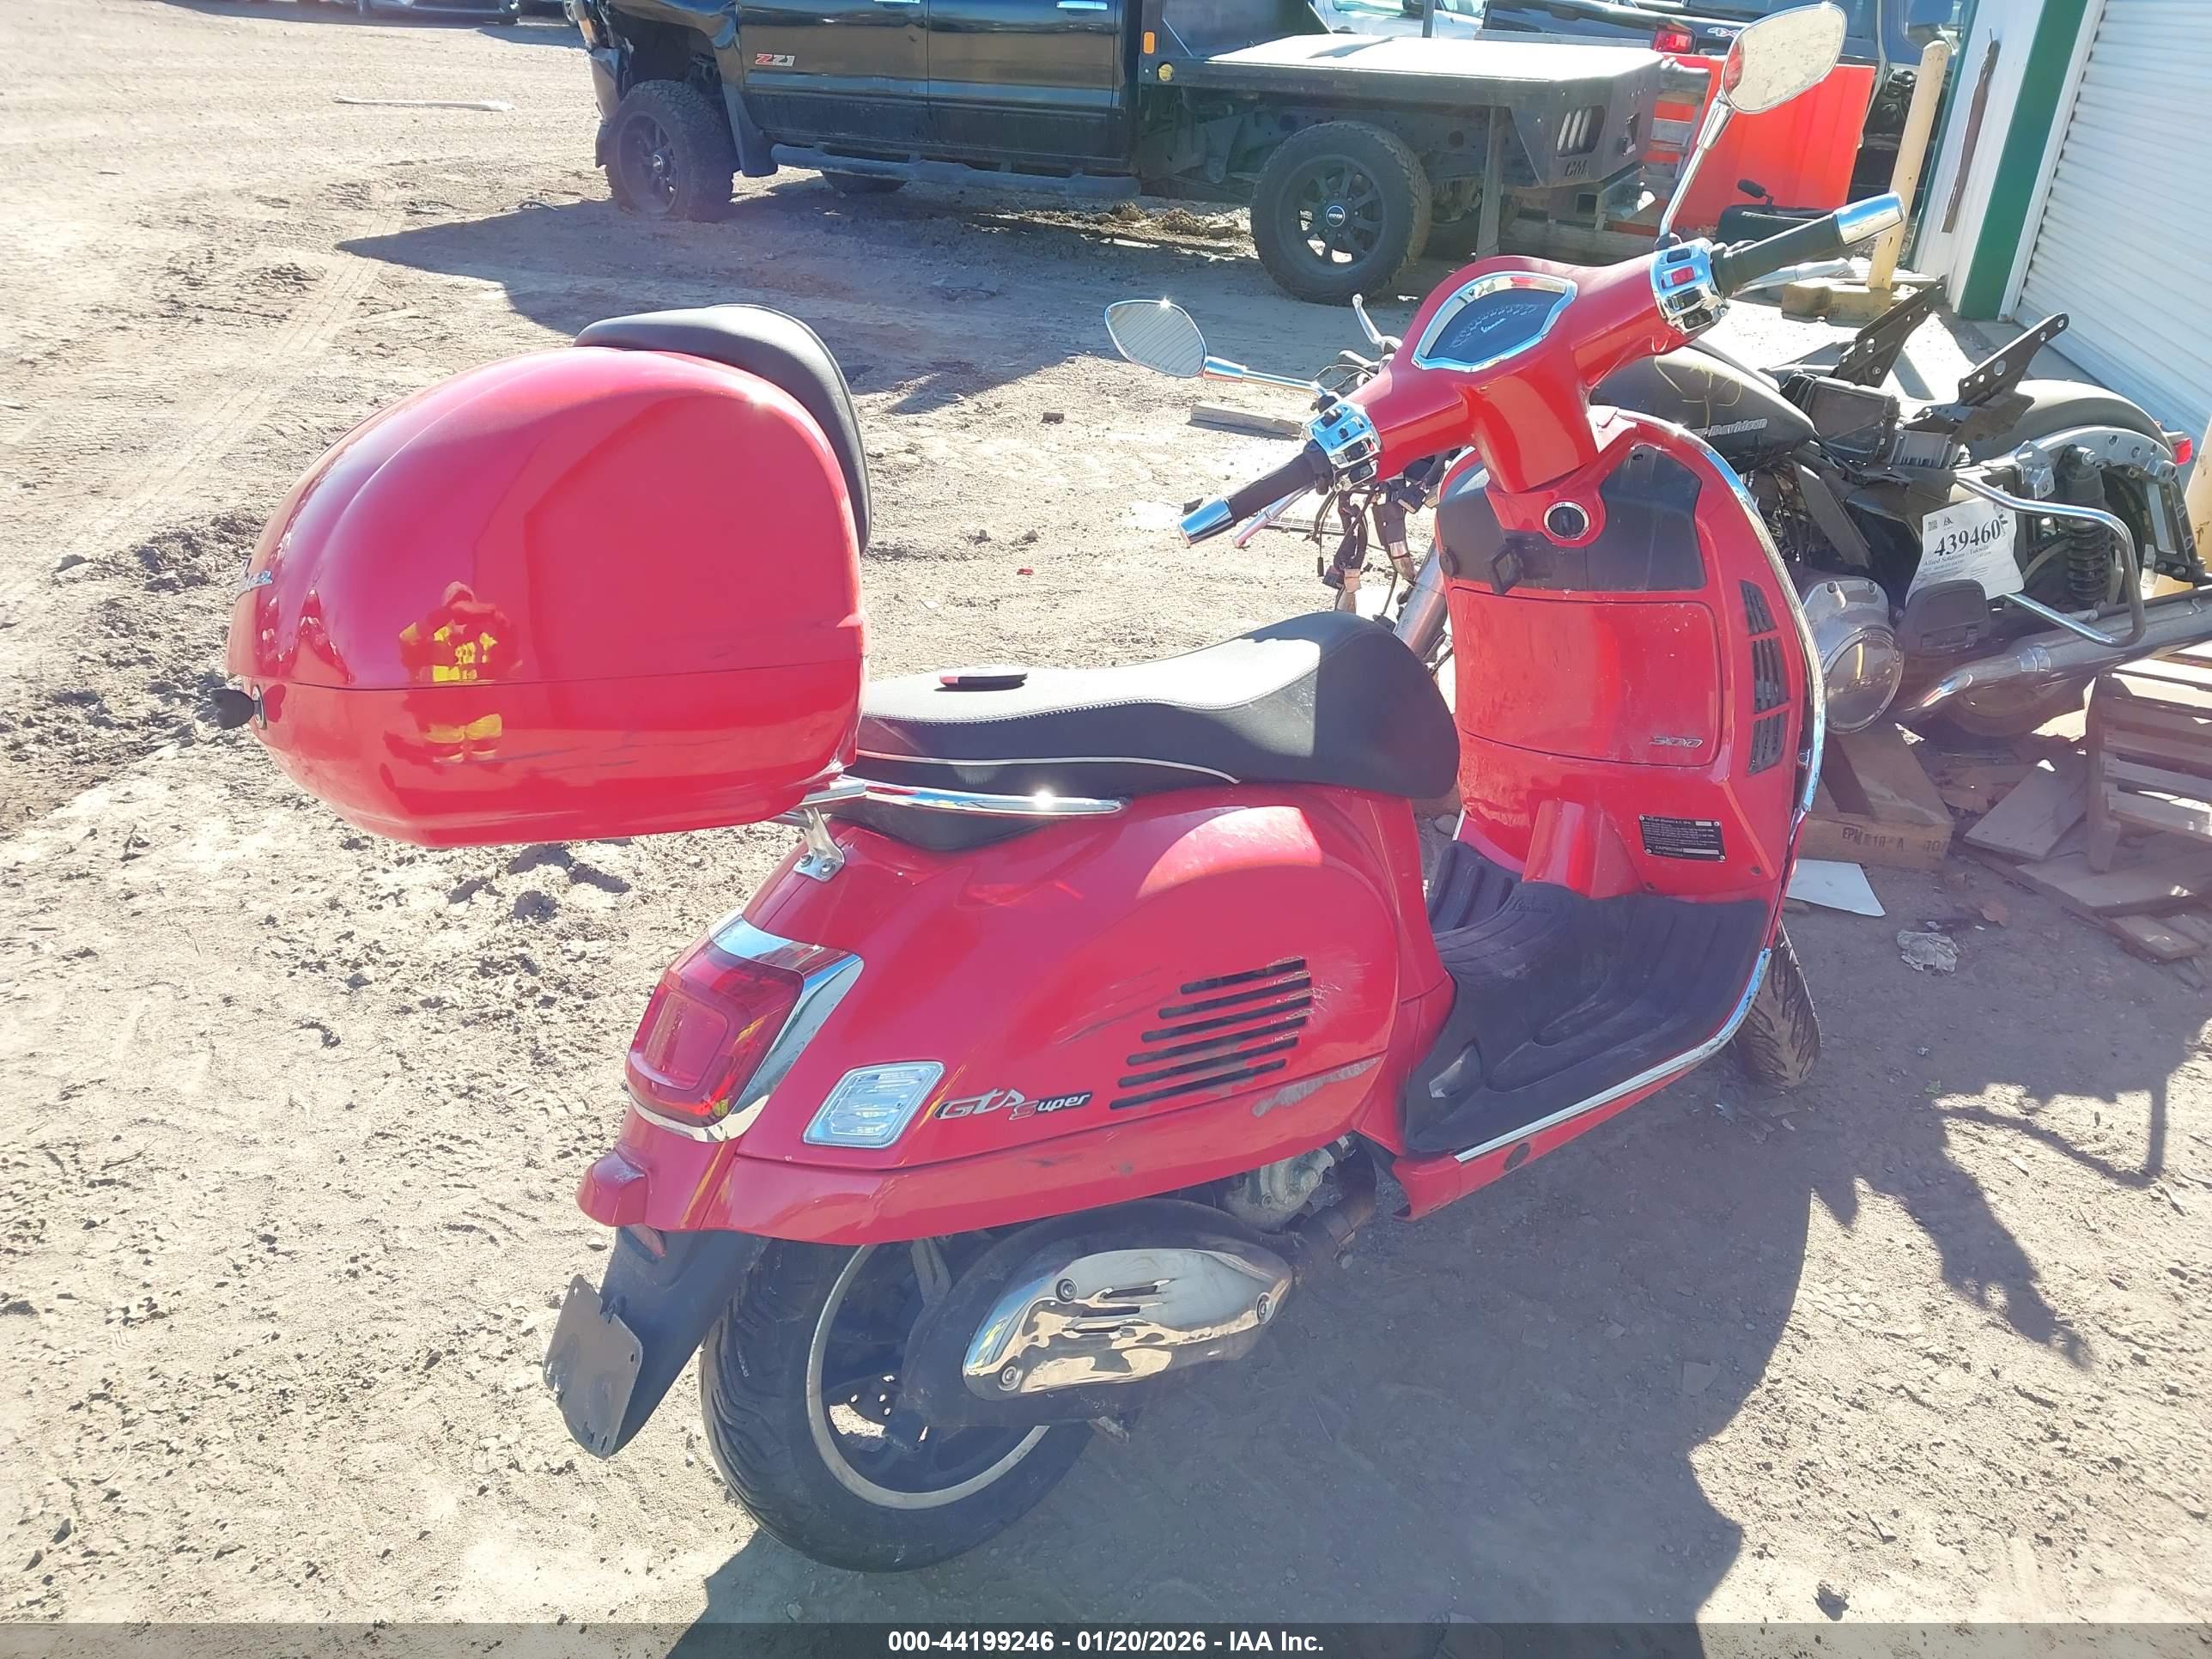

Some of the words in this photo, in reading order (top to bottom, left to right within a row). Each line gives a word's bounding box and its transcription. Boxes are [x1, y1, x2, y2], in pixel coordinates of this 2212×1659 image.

[756, 53, 795, 66] Z71
[1934, 519, 2001, 556] 439460
[1649, 736, 1704, 748] 300
